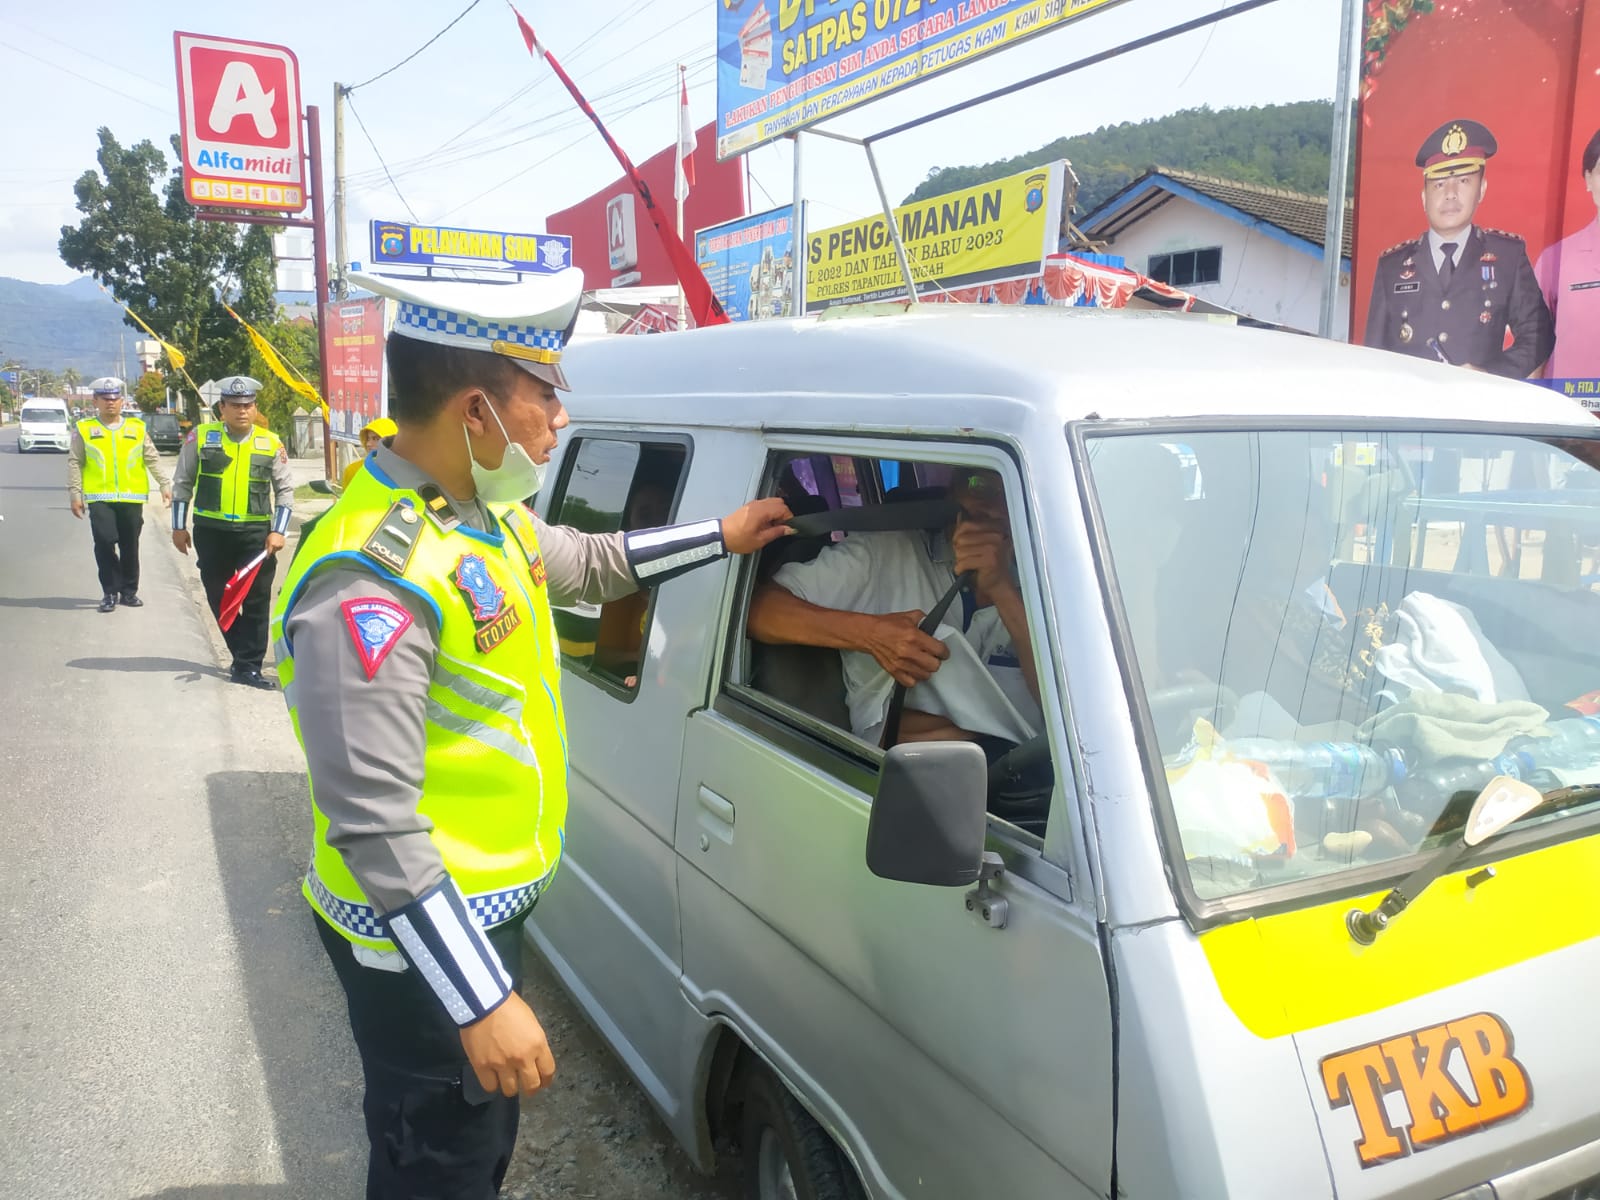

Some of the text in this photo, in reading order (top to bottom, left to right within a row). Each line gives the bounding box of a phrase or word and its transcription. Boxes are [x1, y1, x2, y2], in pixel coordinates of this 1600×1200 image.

[782, 1, 868, 75] SATPAS
[725, 0, 1009, 129] LAKUKAN PENGURUSAN SIM ANDA SECARA LANG
[763, 0, 1067, 137] TANYAKAN DAN PERCAYAKAN KEPADA PETUGAS KAMI KAMI SIAP
[197, 150, 291, 175] Alfamidi
[410, 226, 538, 262] PELAYANAN SIM
[817, 265, 842, 282] 2022
[845, 258, 869, 277] DAN
[872, 247, 918, 271] TAHN
[921, 238, 962, 262] BARU
[965, 229, 1004, 251] 2023
[816, 281, 850, 298] POLRES
[852, 272, 897, 291] TAPANULI
[899, 262, 945, 282] TNGAH
[1577, 381, 1594, 394] FITA
[371, 541, 405, 566] POLISI
[480, 608, 518, 648] TOTOK
[1319, 1012, 1533, 1168] TKB
